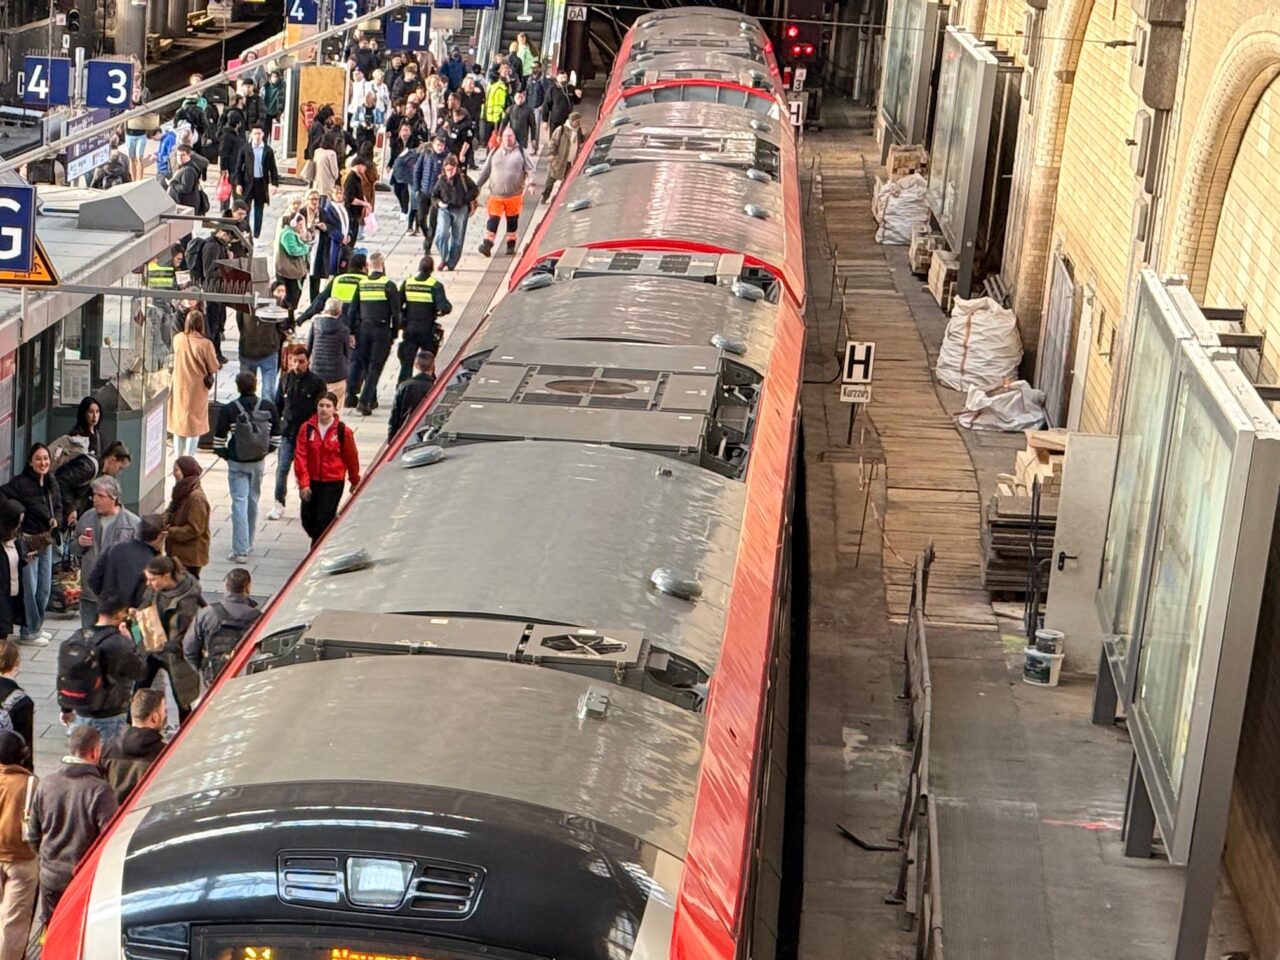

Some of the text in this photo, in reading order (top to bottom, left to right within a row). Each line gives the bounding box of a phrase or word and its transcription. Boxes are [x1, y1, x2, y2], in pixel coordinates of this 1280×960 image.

[290, 0, 304, 21] 4
[344, 0, 357, 23] 3
[403, 13, 427, 46] H
[27, 65, 49, 99] 4
[106, 69, 127, 104] 3
[847, 345, 872, 379] H
